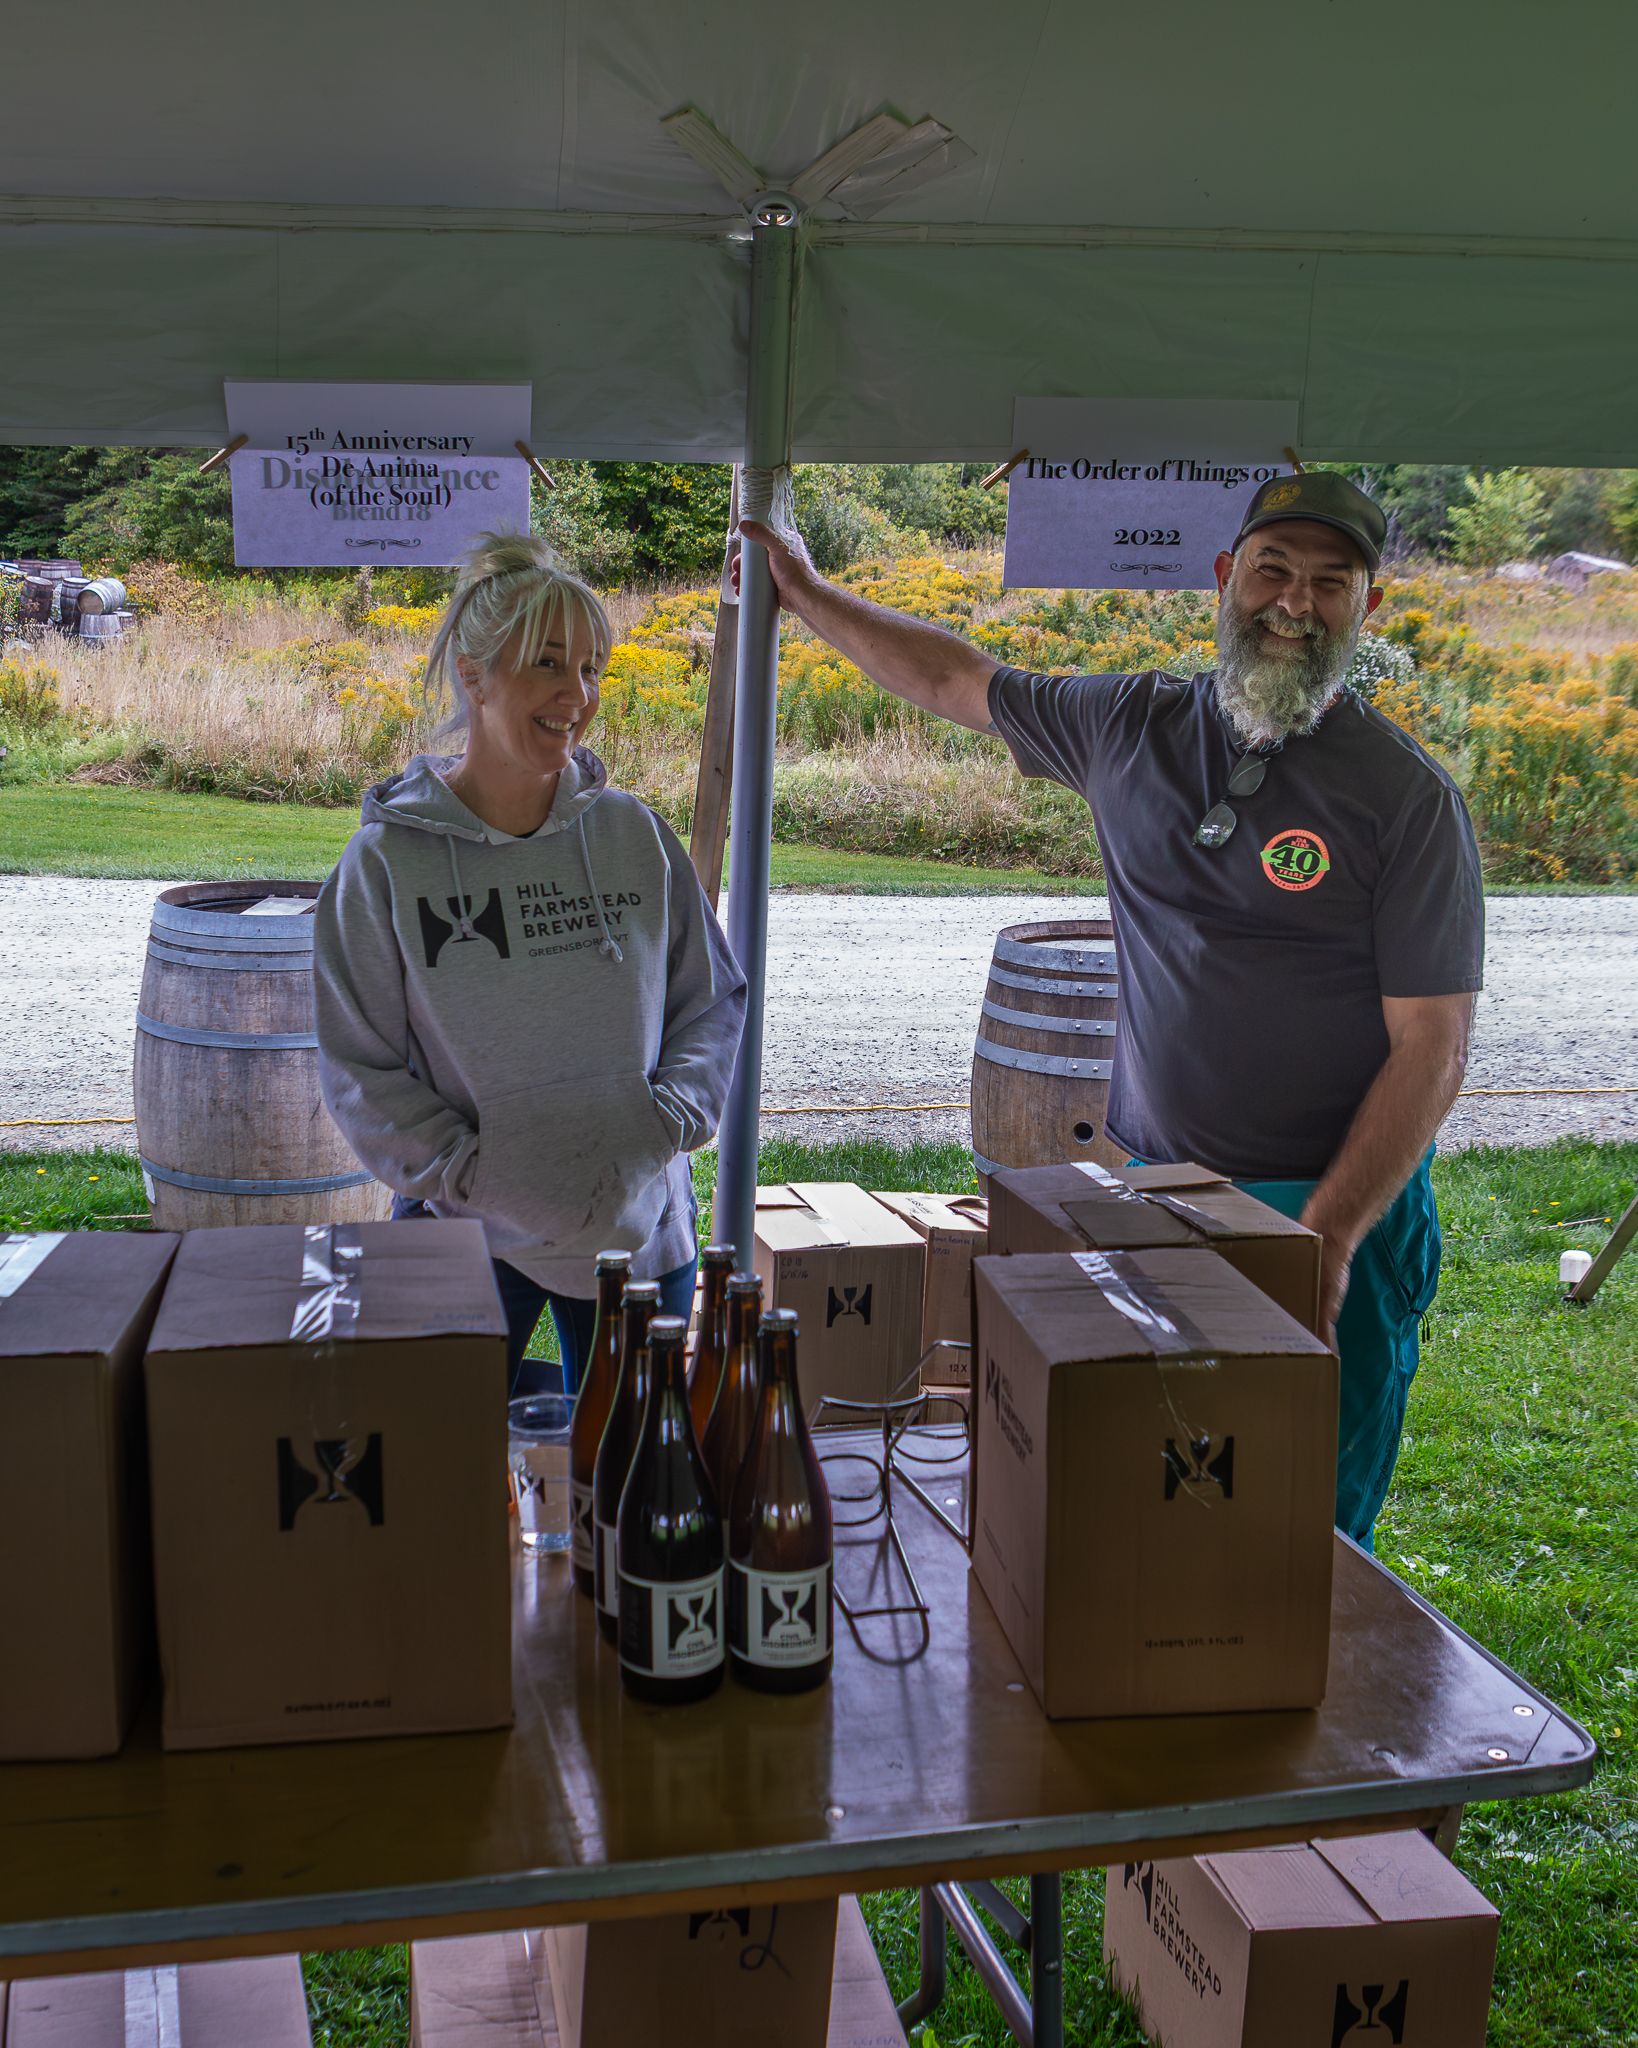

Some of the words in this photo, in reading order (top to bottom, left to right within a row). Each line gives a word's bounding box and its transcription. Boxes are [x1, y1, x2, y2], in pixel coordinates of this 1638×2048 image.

[285, 427, 325, 455] 15th
[331, 430, 475, 457] Anniversary
[321, 456, 356, 478] De
[360, 455, 440, 478] Anima
[1023, 457, 1068, 479] The
[1072, 457, 1141, 481] Order
[1144, 459, 1173, 481] of
[1173, 459, 1250, 490] Things
[310, 483, 348, 510] (of
[348, 484, 386, 506] the
[389, 483, 452, 510] Soul)
[1113, 528, 1181, 546] 2022
[1270, 846, 1321, 875] 40
[1279, 869, 1304, 879] YEARS
[516, 882, 563, 900] HILL
[528, 935, 605, 958] GREENSBOR
[949, 1363, 959, 1373] 12
[1156, 1870, 1181, 1917] HILL
[1153, 1914, 1206, 2000] BREWERY
[1154, 1893, 1222, 1996] FARMSTEAD
